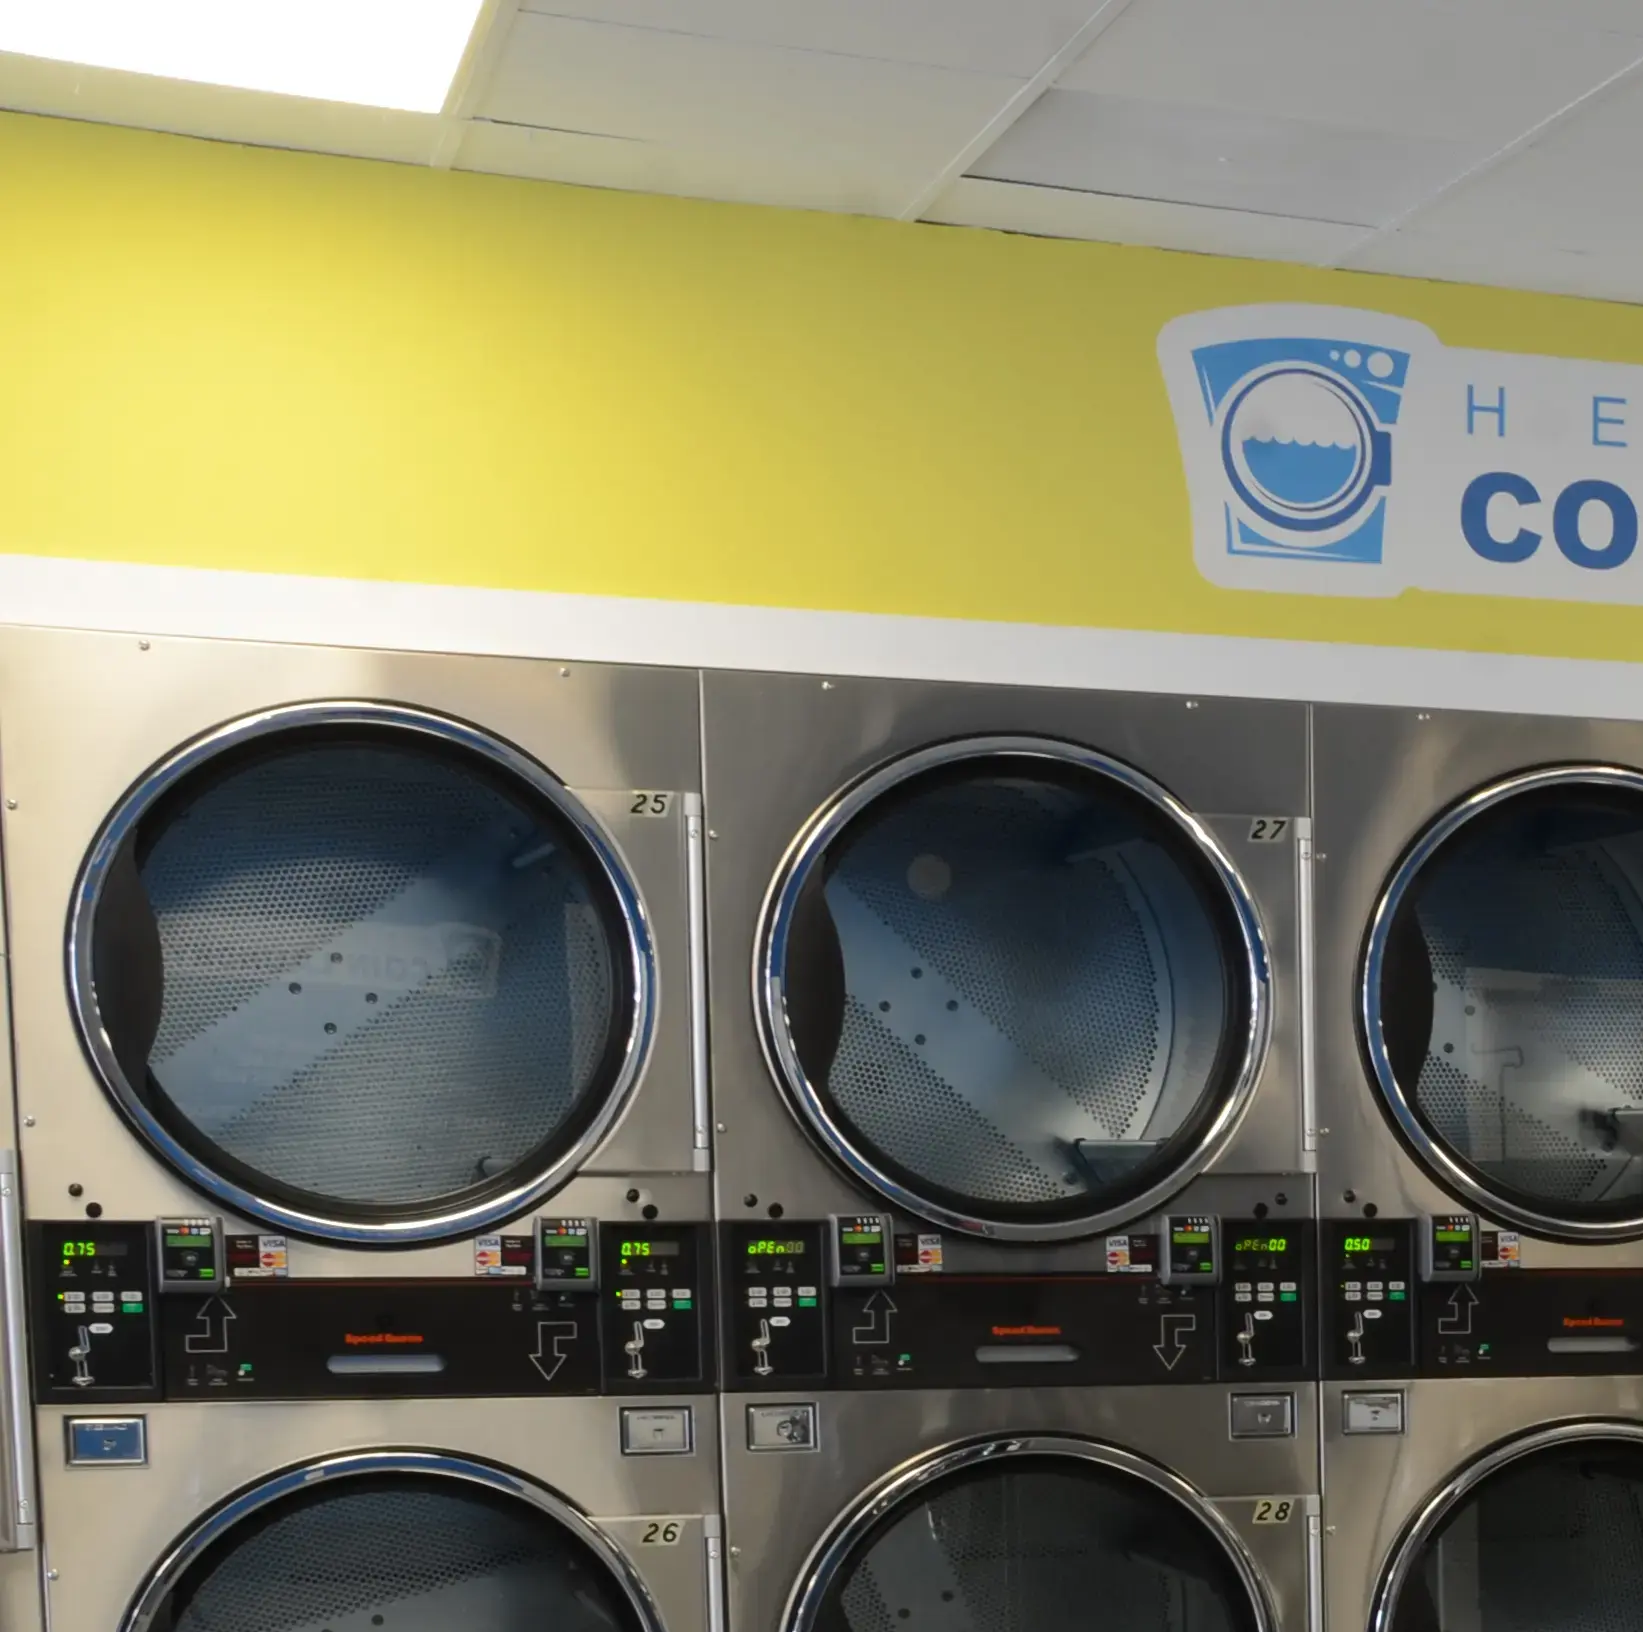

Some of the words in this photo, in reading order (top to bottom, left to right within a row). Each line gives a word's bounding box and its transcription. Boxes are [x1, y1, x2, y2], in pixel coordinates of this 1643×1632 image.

[630, 794, 668, 814] 25
[1251, 819, 1287, 840] 27
[1256, 1501, 1291, 1522] 28
[642, 1522, 679, 1544] 26
